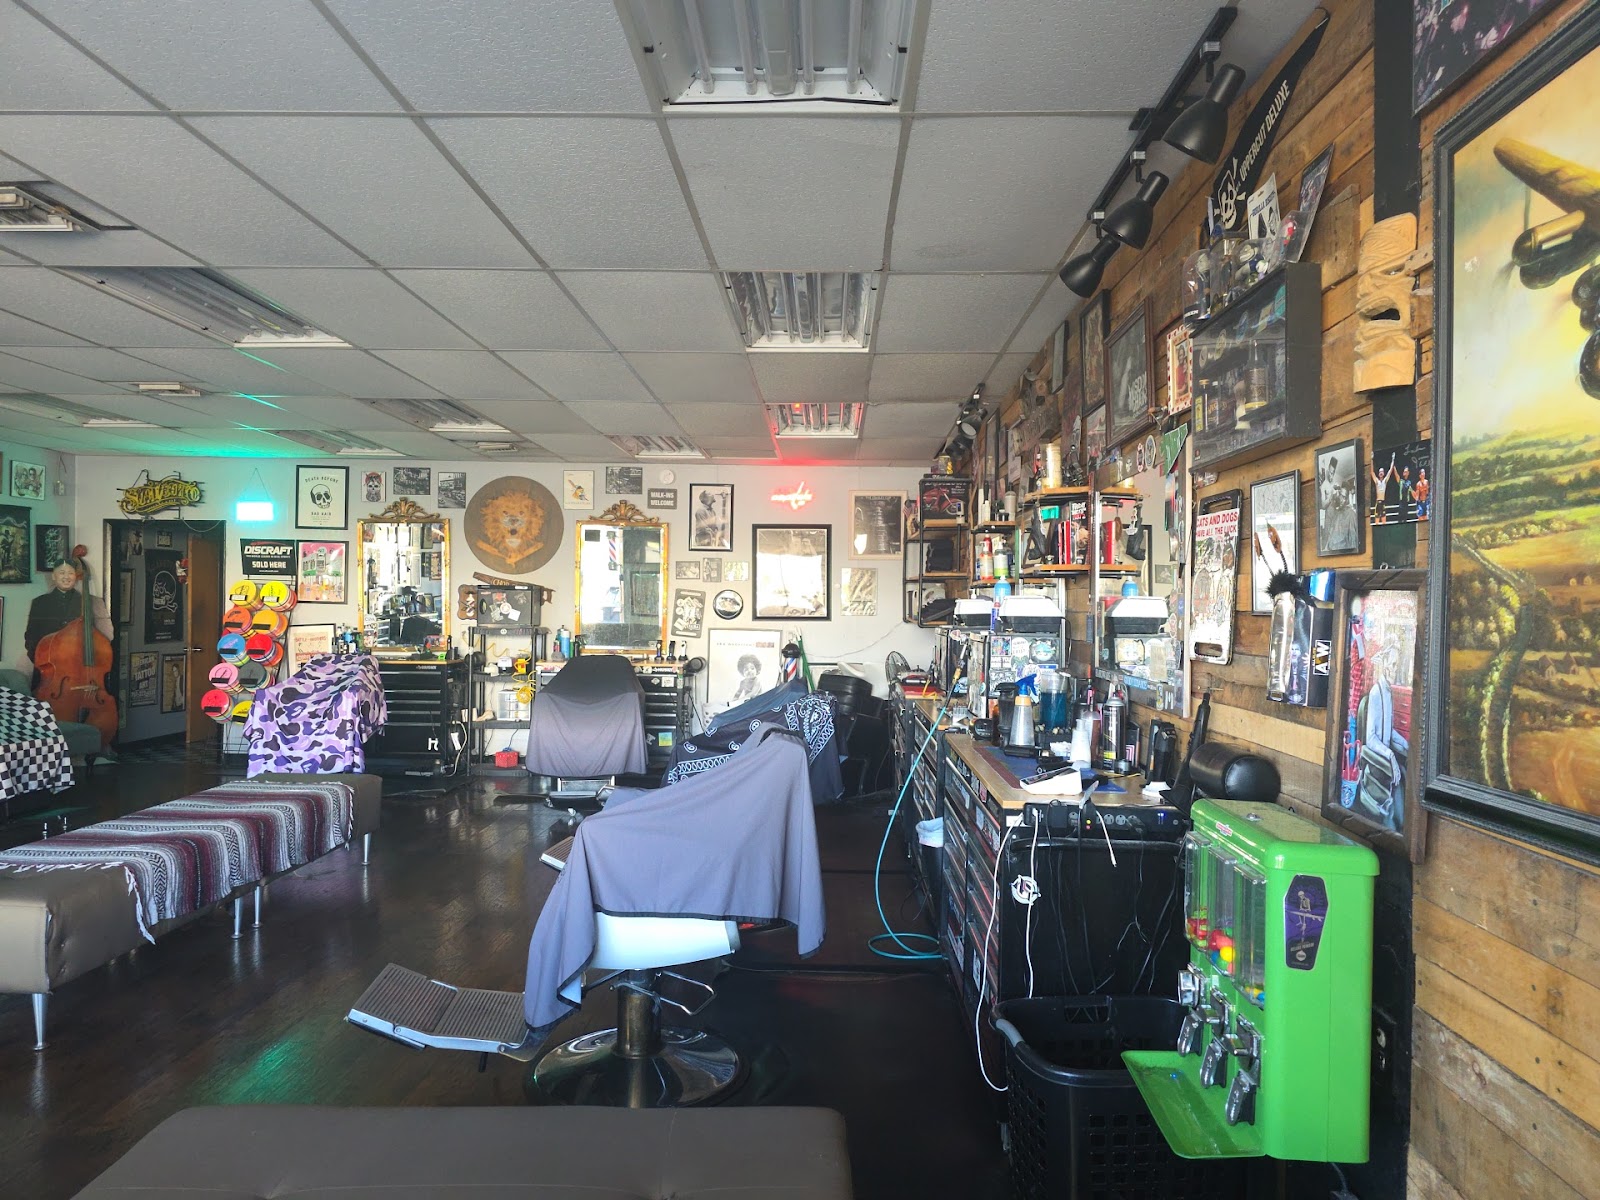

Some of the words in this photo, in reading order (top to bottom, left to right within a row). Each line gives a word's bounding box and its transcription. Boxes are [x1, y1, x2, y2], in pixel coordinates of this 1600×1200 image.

[1239, 122, 1268, 182] UPPERCUT
[1264, 79, 1290, 132] DELUXE
[1196, 516, 1209, 527] CATS
[1209, 514, 1221, 525] AND
[1221, 511, 1238, 524] DOGS
[1214, 526, 1224, 535] THE
[1224, 524, 1237, 534] LUCK
[243, 545, 294, 555] DISCRAFT
[252, 560, 269, 568] SOLD
[269, 561, 287, 569] HERE
